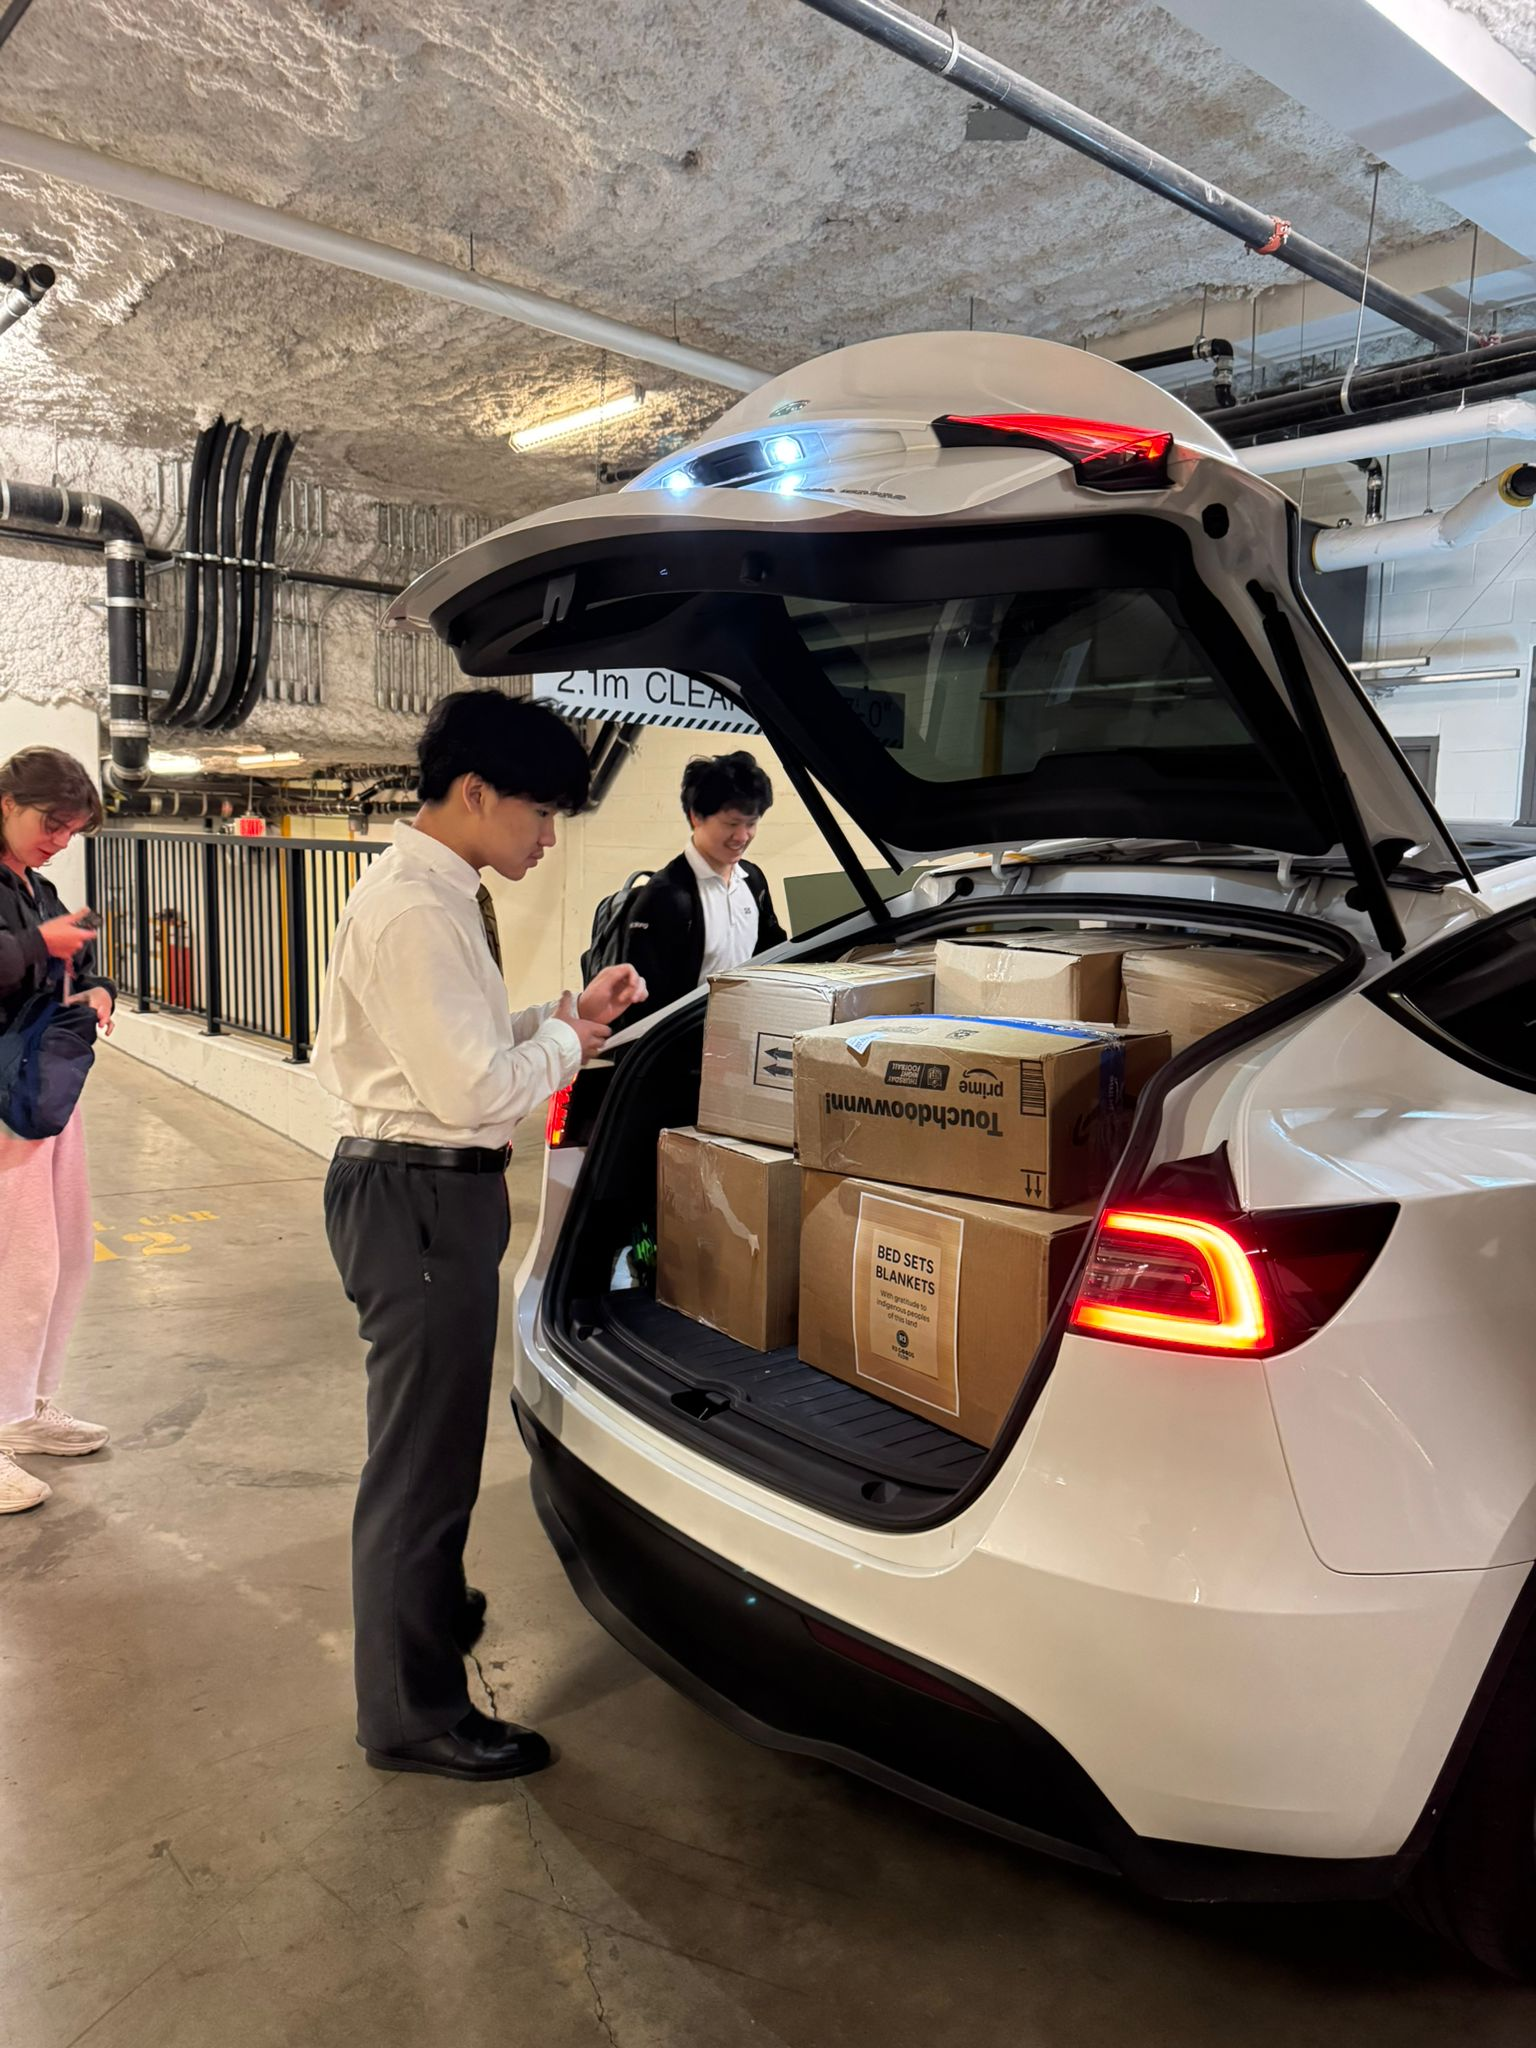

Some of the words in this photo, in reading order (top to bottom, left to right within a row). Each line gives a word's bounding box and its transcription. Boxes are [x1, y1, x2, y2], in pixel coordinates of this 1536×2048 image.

[645, 671, 738, 711] CLEA
[959, 1081, 1004, 1098] prime
[825, 1092, 1003, 1137] Touchdoowwnn!
[877, 1245, 901, 1264] BED
[903, 1252, 934, 1274] SETS
[875, 1265, 935, 1295] BLANKETS
[907, 1309, 930, 1323] peoples
